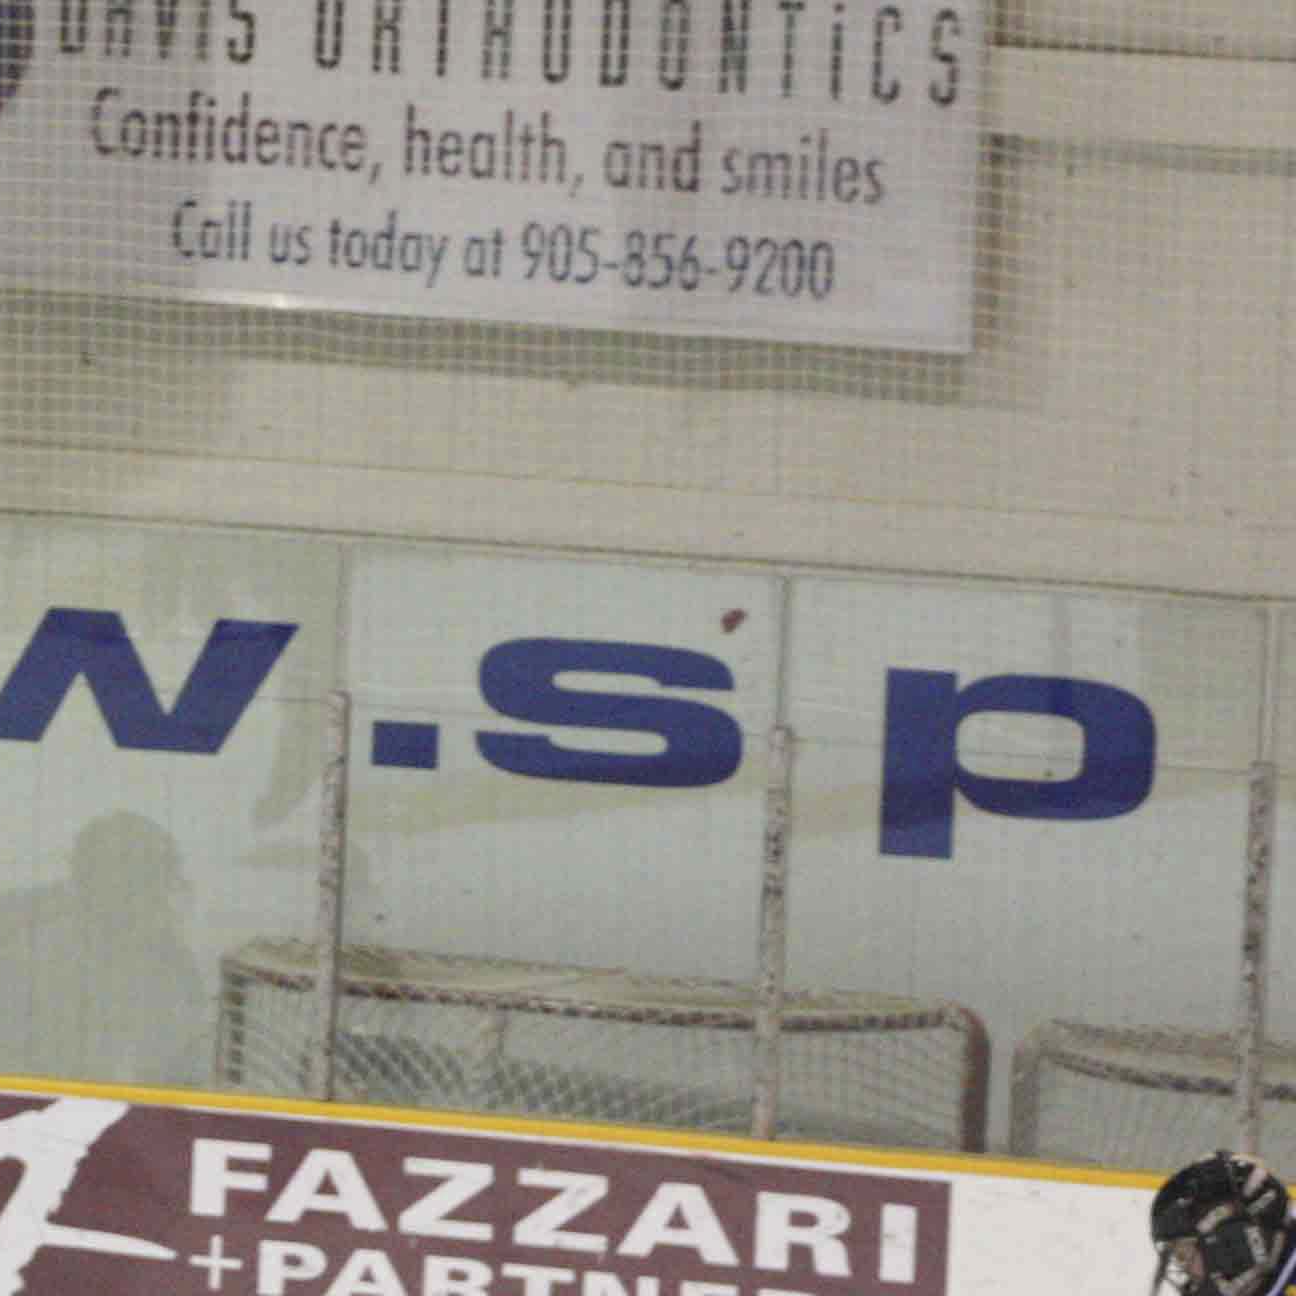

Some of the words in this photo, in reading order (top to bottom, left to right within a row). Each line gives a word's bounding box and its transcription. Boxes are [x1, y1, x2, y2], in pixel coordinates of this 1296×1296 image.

[91, 87, 383, 184] Confidence,
[404, 103, 584, 198] health,
[603, 120, 702, 193] and
[720, 128, 885, 203] smiles
[171, 200, 252, 261] Call
[269, 222, 311, 265] us
[329, 210, 449, 283] today
[463, 226, 503, 279] at
[520, 222, 836, 300] 905-856-9200
[188, 1137, 919, 1284] FAZZARI
